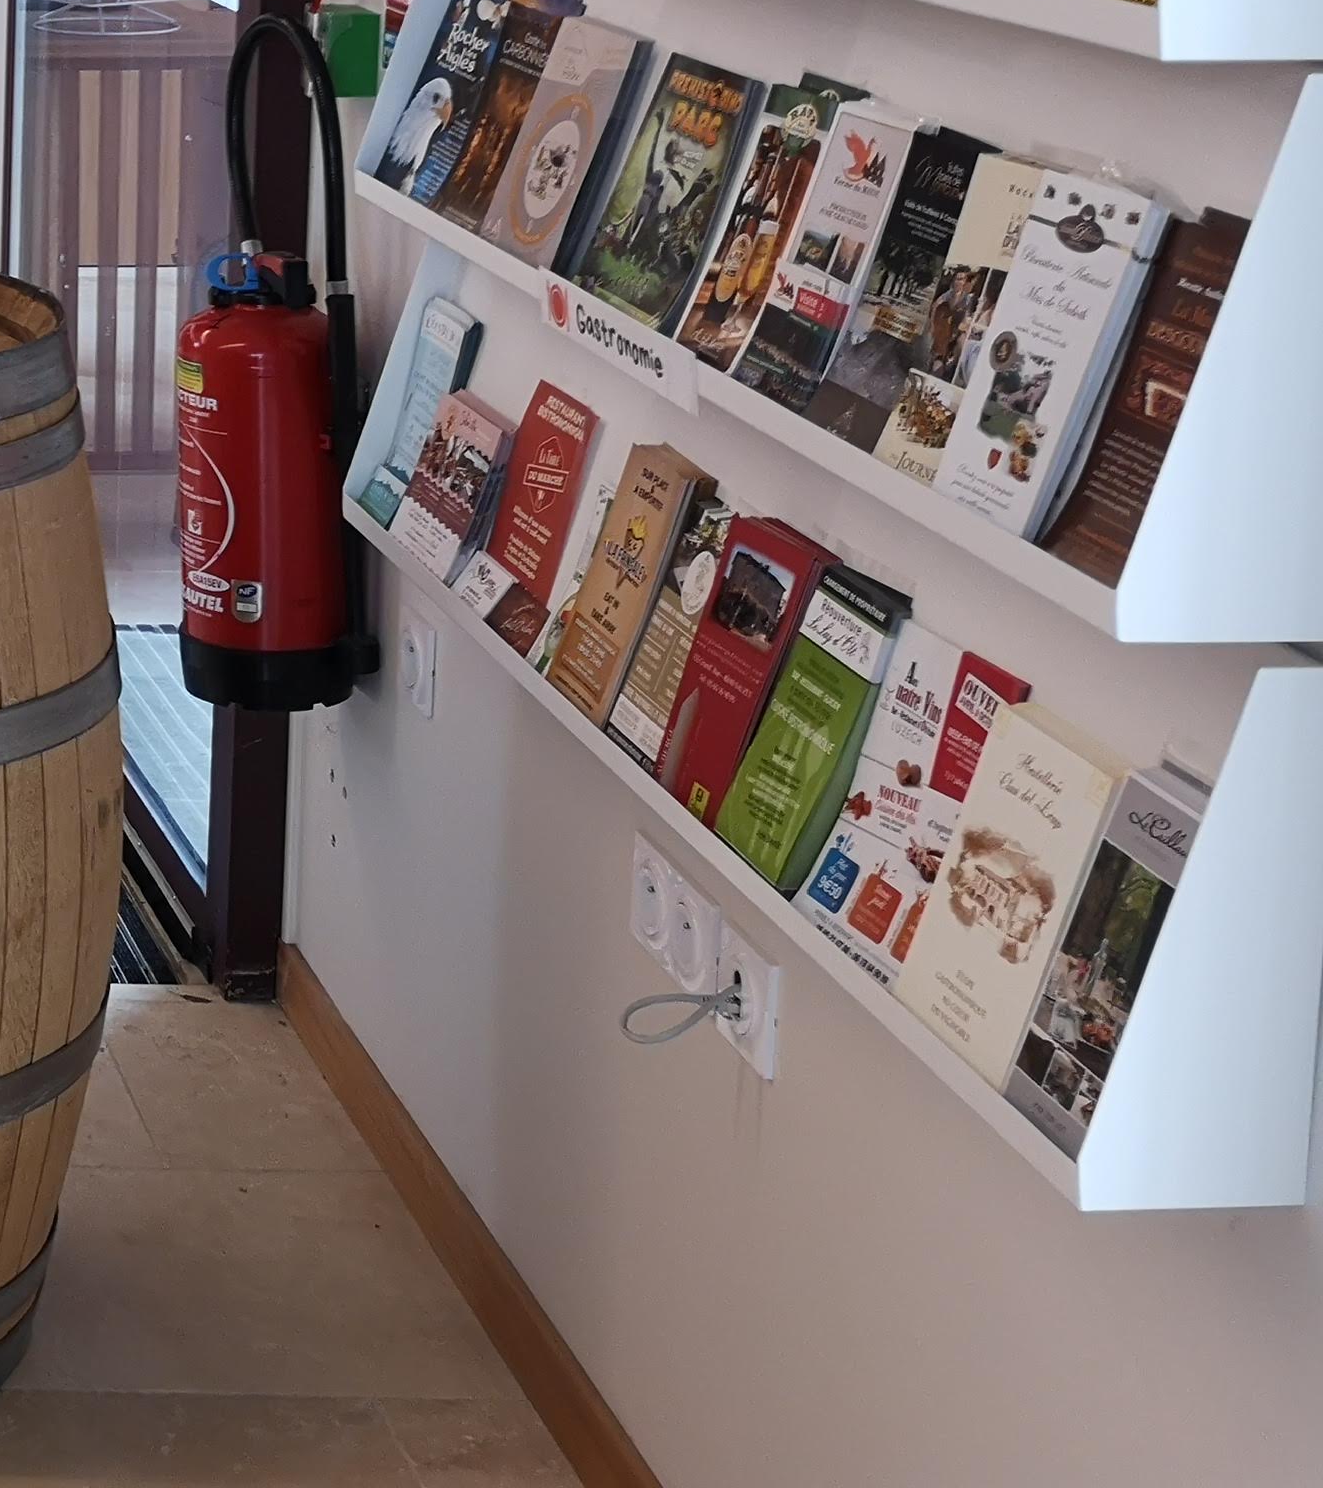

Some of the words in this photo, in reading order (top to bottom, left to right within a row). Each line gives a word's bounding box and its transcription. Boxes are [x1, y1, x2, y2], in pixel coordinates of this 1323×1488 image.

[437, 43, 477, 72] Aigles
[575, 303, 665, 379] Gastronomie
[181, 585, 225, 614] AUTEL
[237, 586, 256, 597] NF
[877, 784, 922, 813] NOUVEAU
